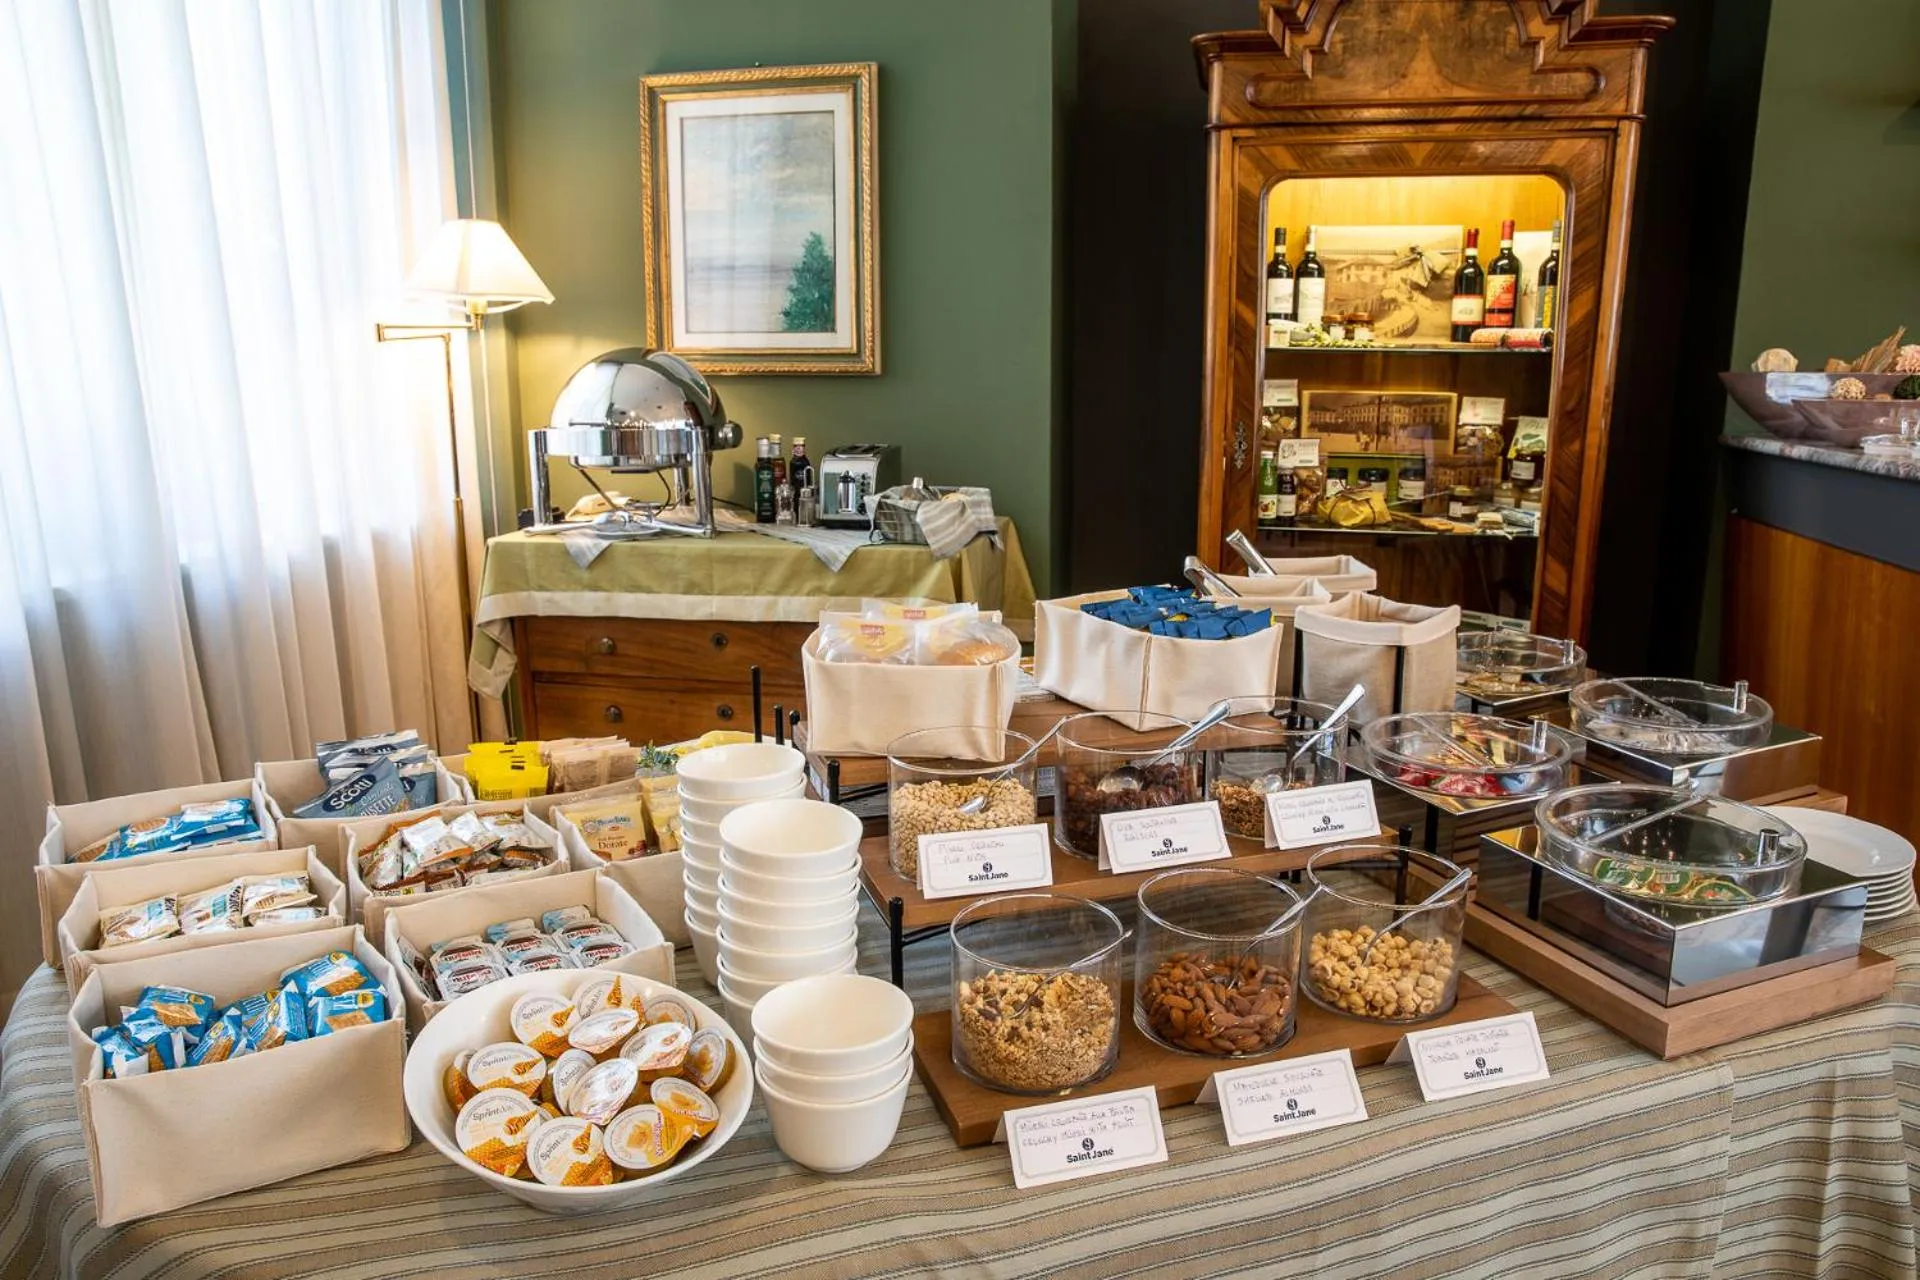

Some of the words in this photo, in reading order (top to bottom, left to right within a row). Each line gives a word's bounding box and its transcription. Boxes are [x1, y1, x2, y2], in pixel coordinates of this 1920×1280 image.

[1151, 848, 1171, 858] Saint
[968, 872, 991, 882] Saint
[1464, 1068, 1486, 1080] Saint
[1486, 1066, 1504, 1077] Jane
[1273, 1111, 1297, 1124] Saint
[1297, 1107, 1317, 1119] Jane
[1066, 1150, 1092, 1164] Saint
[1092, 1147, 1115, 1159] Jane
